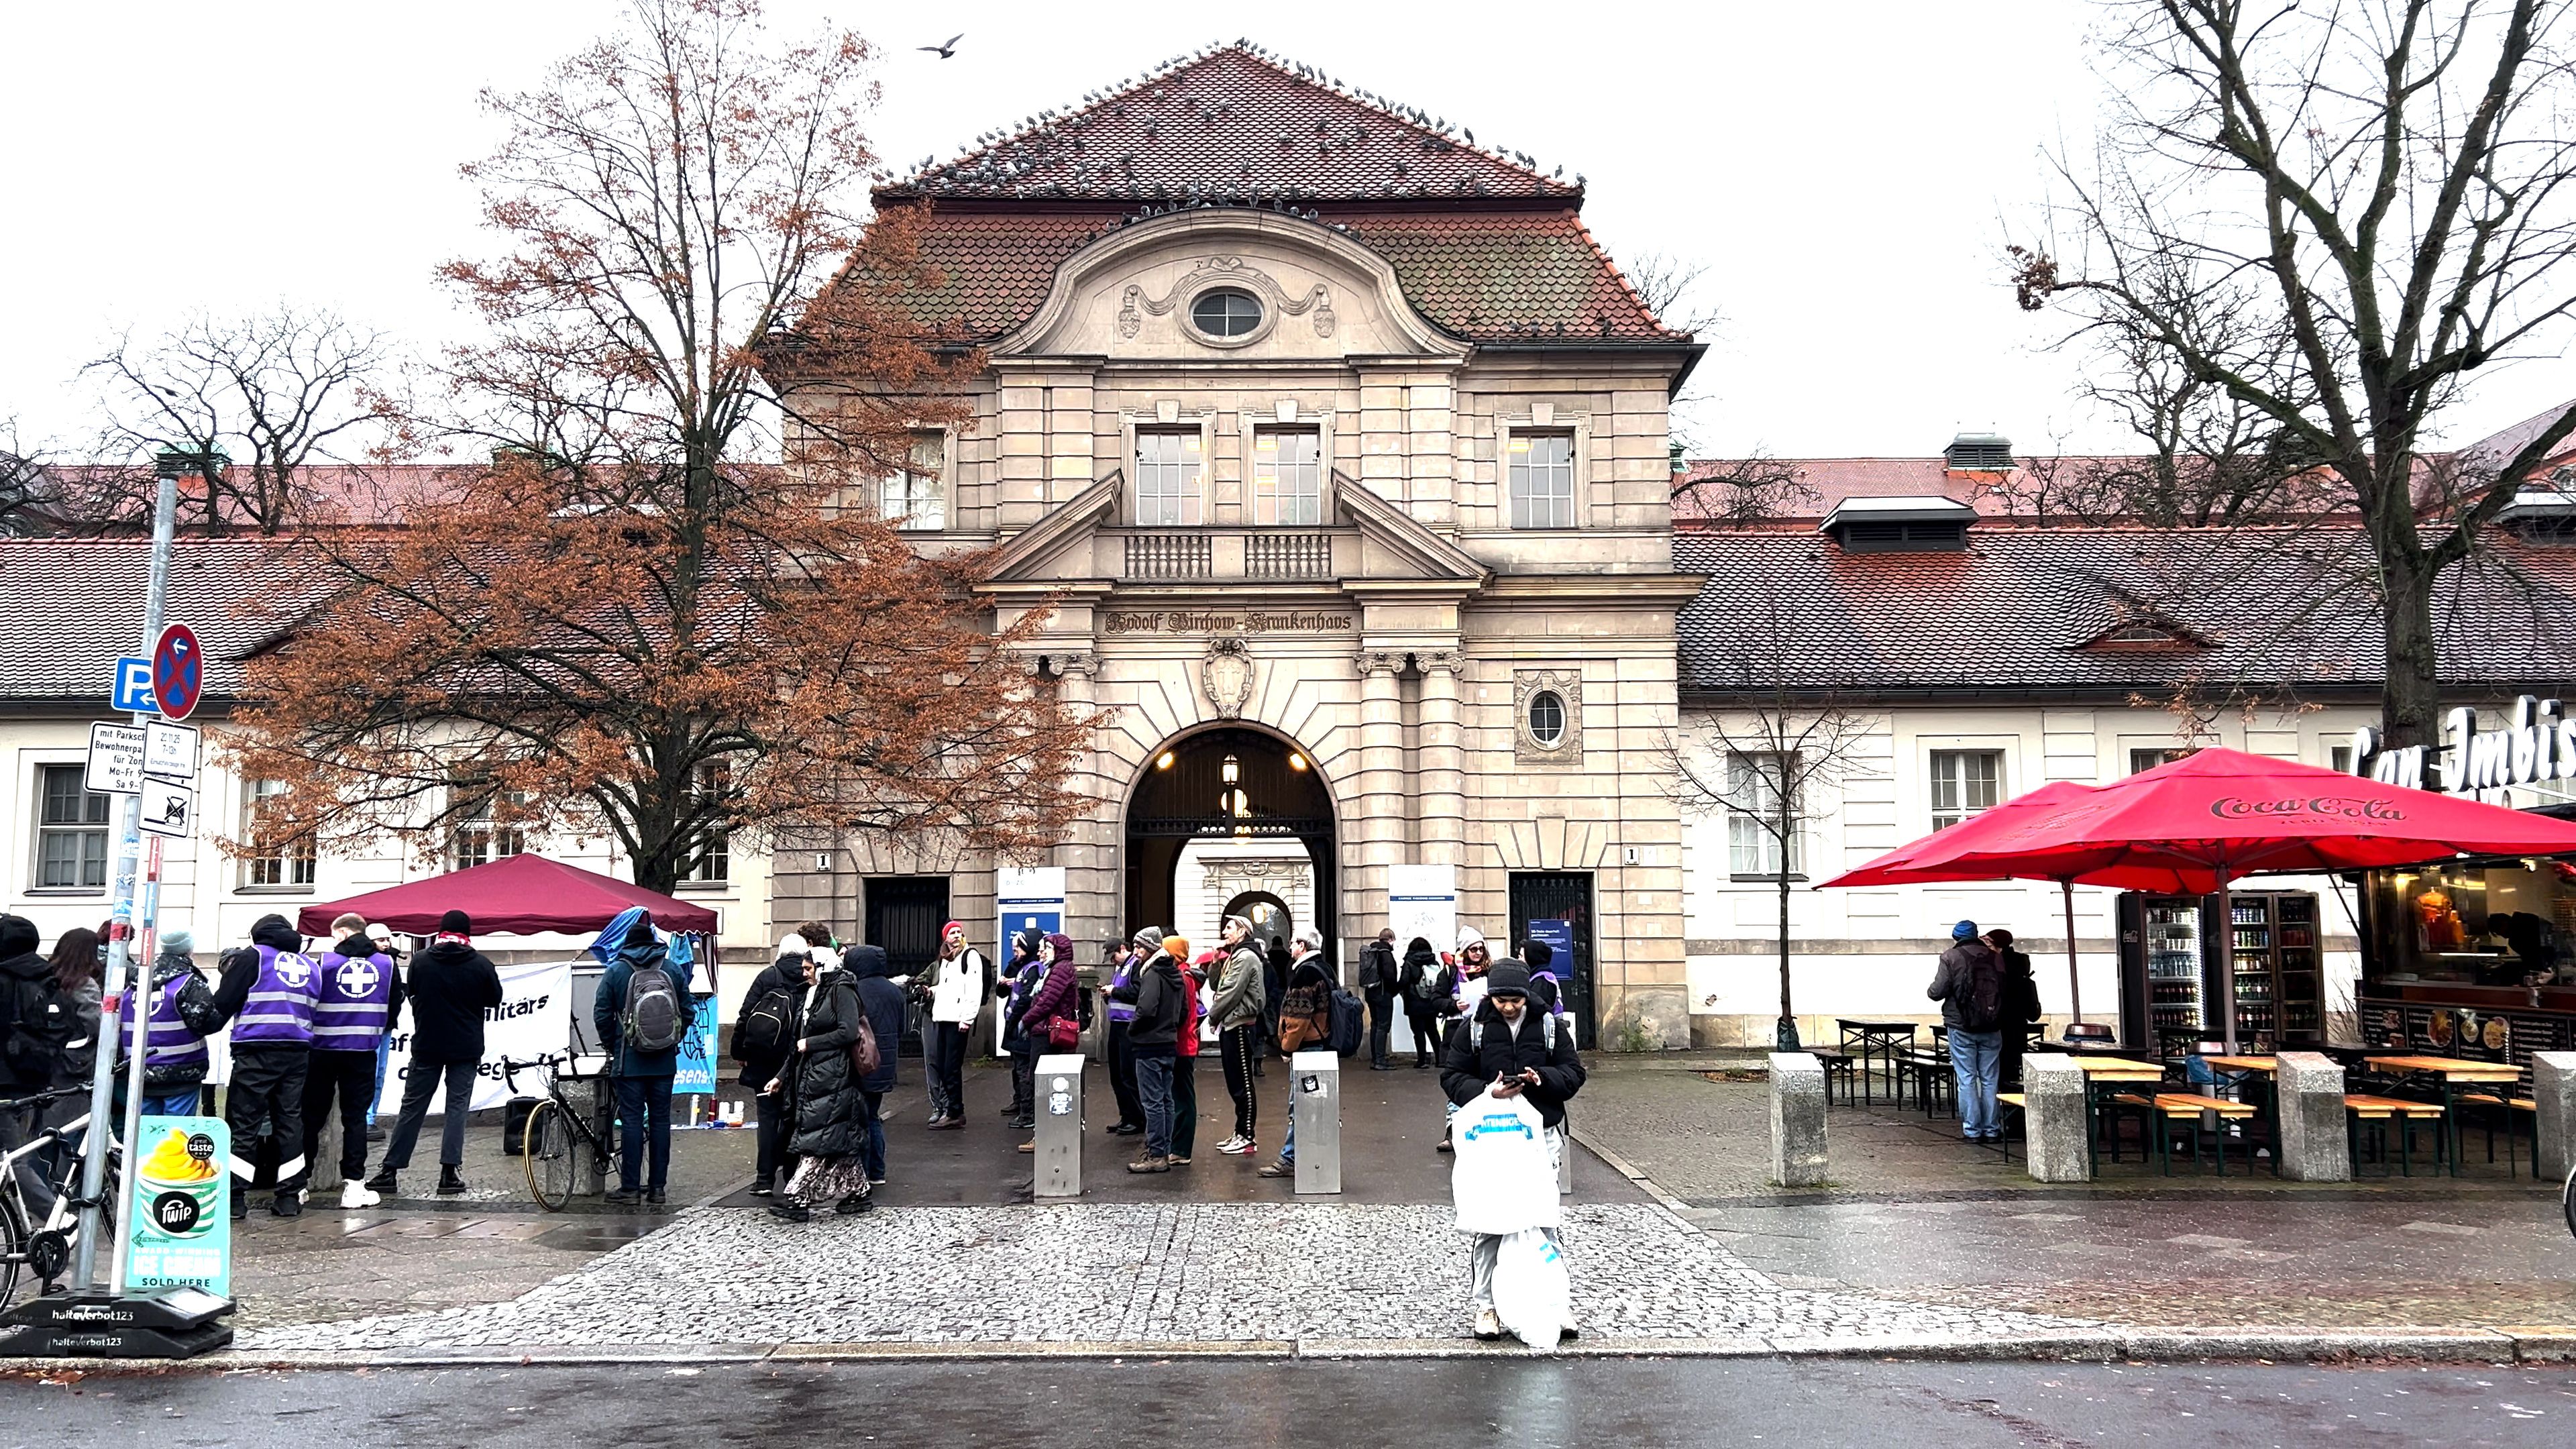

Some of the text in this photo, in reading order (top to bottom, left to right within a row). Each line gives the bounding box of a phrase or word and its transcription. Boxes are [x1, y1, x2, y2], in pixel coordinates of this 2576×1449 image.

[123, 663, 154, 704] P
[100, 730, 113, 738] mit
[114, 755, 125, 763] für
[109, 767, 133, 777] Mo-Fr
[116, 780, 125, 788] Sa
[1629, 849, 1634, 859] 1
[820, 855, 826, 866] 1
[189, 1144, 213, 1152] taste
[133, 1256, 158, 1276] ICE
[142, 1278, 174, 1286] SOLD
